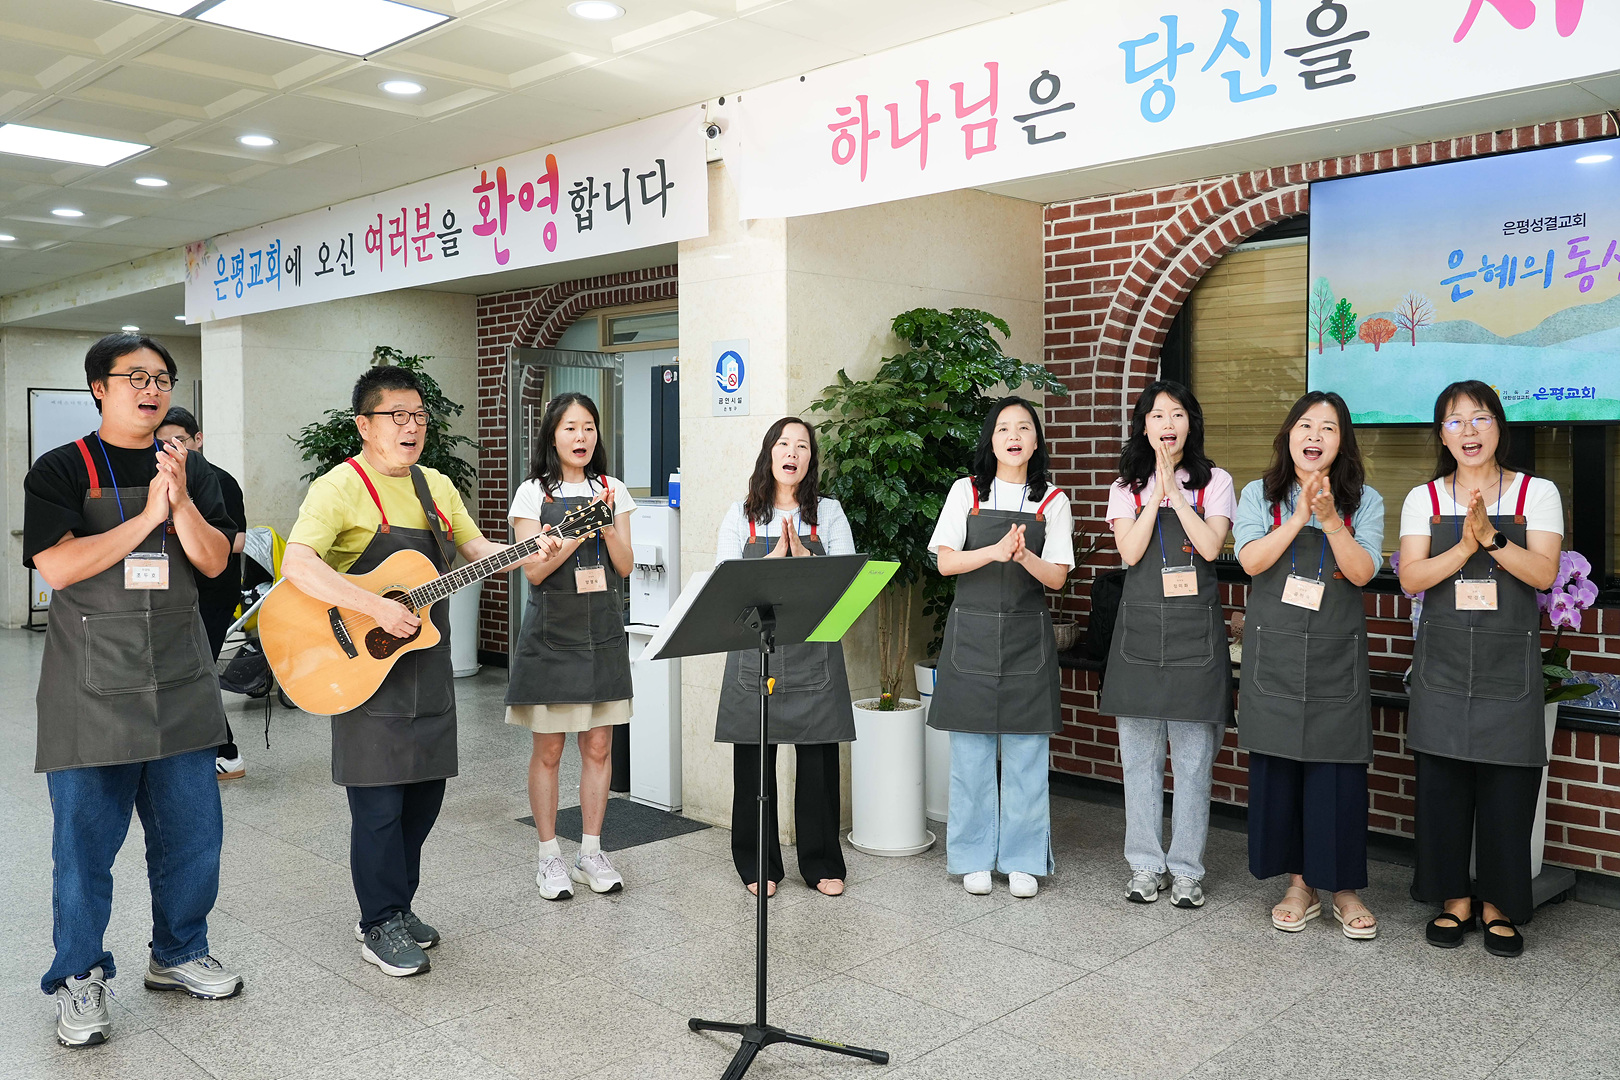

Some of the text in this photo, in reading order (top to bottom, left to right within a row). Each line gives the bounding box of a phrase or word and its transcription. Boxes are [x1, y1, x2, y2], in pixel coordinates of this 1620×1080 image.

[827, 0, 1370, 182] 하나님은 당신을
[213, 153, 675, 301] 은평교회에 오신 여러분을 환영합니다
[1502, 212, 1587, 236] 은평성결교회
[1440, 249, 1555, 303] 은혜의
[718, 396, 743, 405] 금연시설
[1532, 386, 1596, 401] 은평교회
